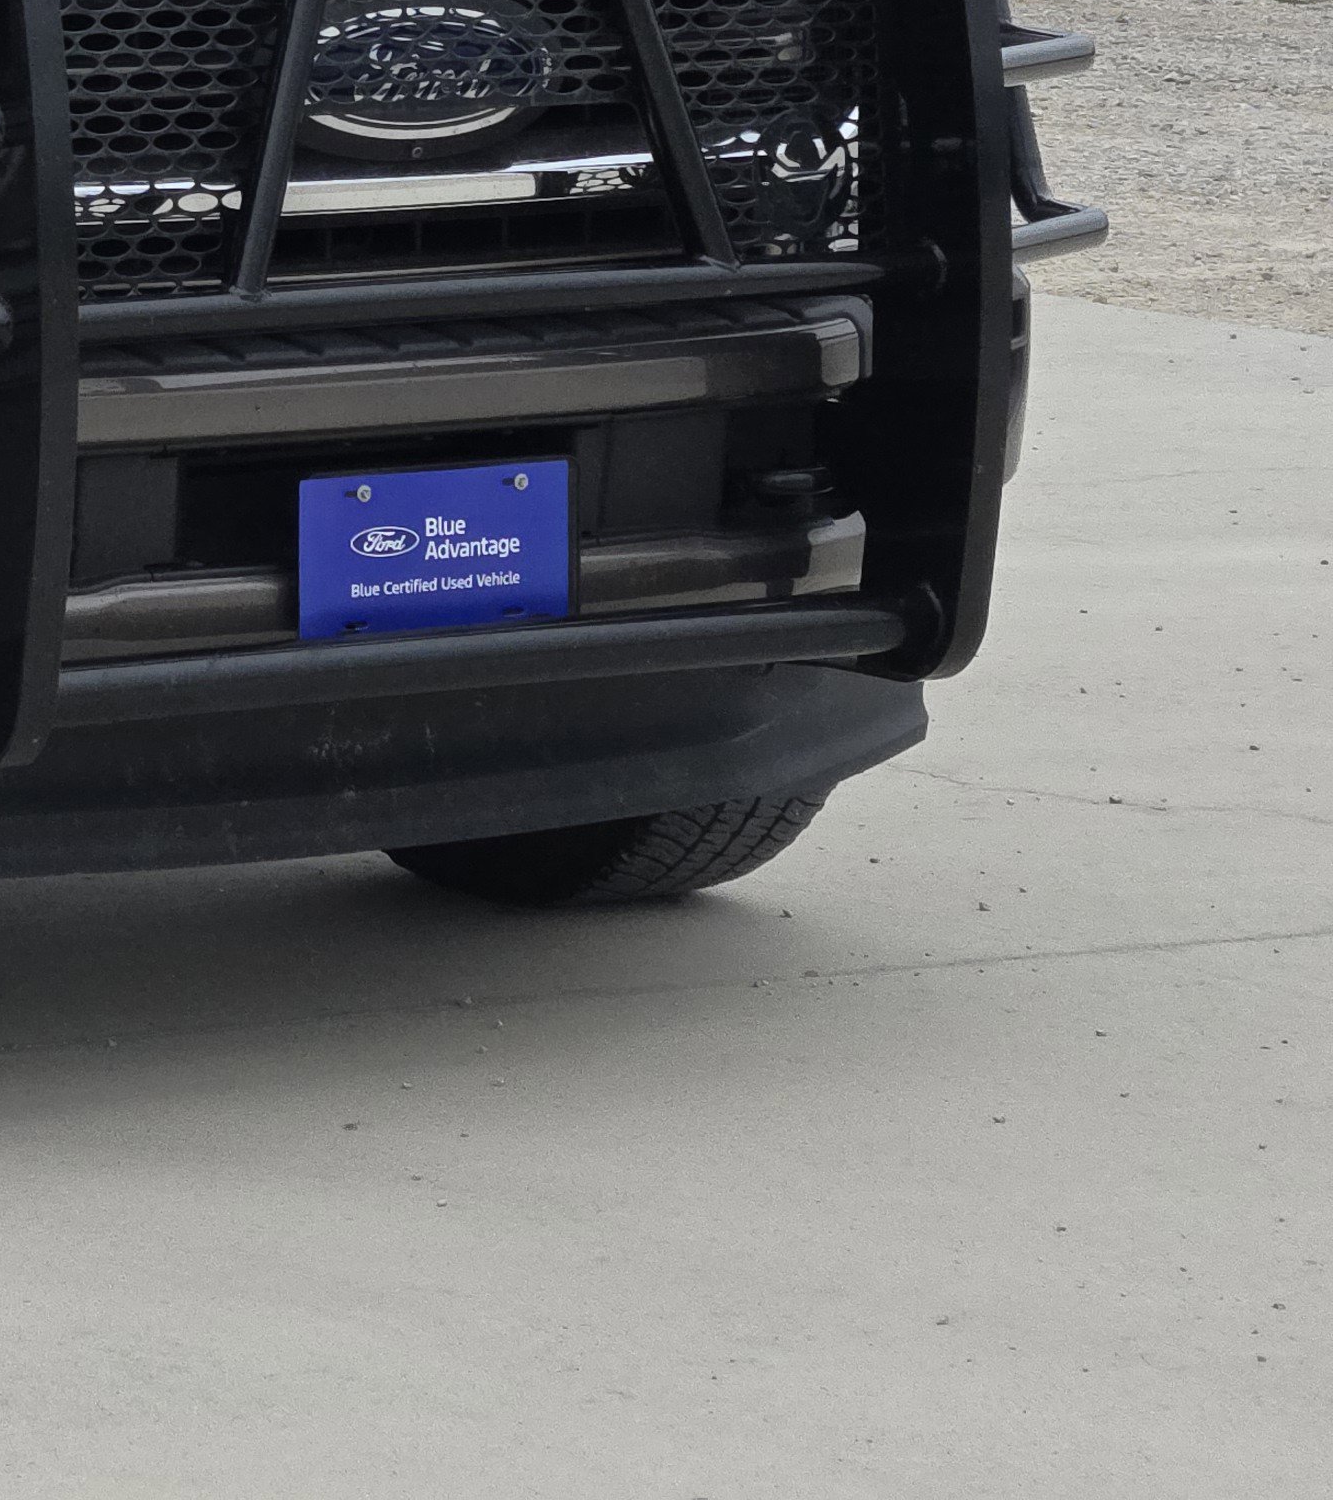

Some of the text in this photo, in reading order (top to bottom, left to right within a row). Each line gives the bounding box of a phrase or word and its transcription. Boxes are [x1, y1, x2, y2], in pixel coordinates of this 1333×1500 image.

[425, 517, 466, 536] Blue
[363, 530, 520, 560] Ford Advantage
[351, 571, 520, 598] Blue Certified Used Vehicle
